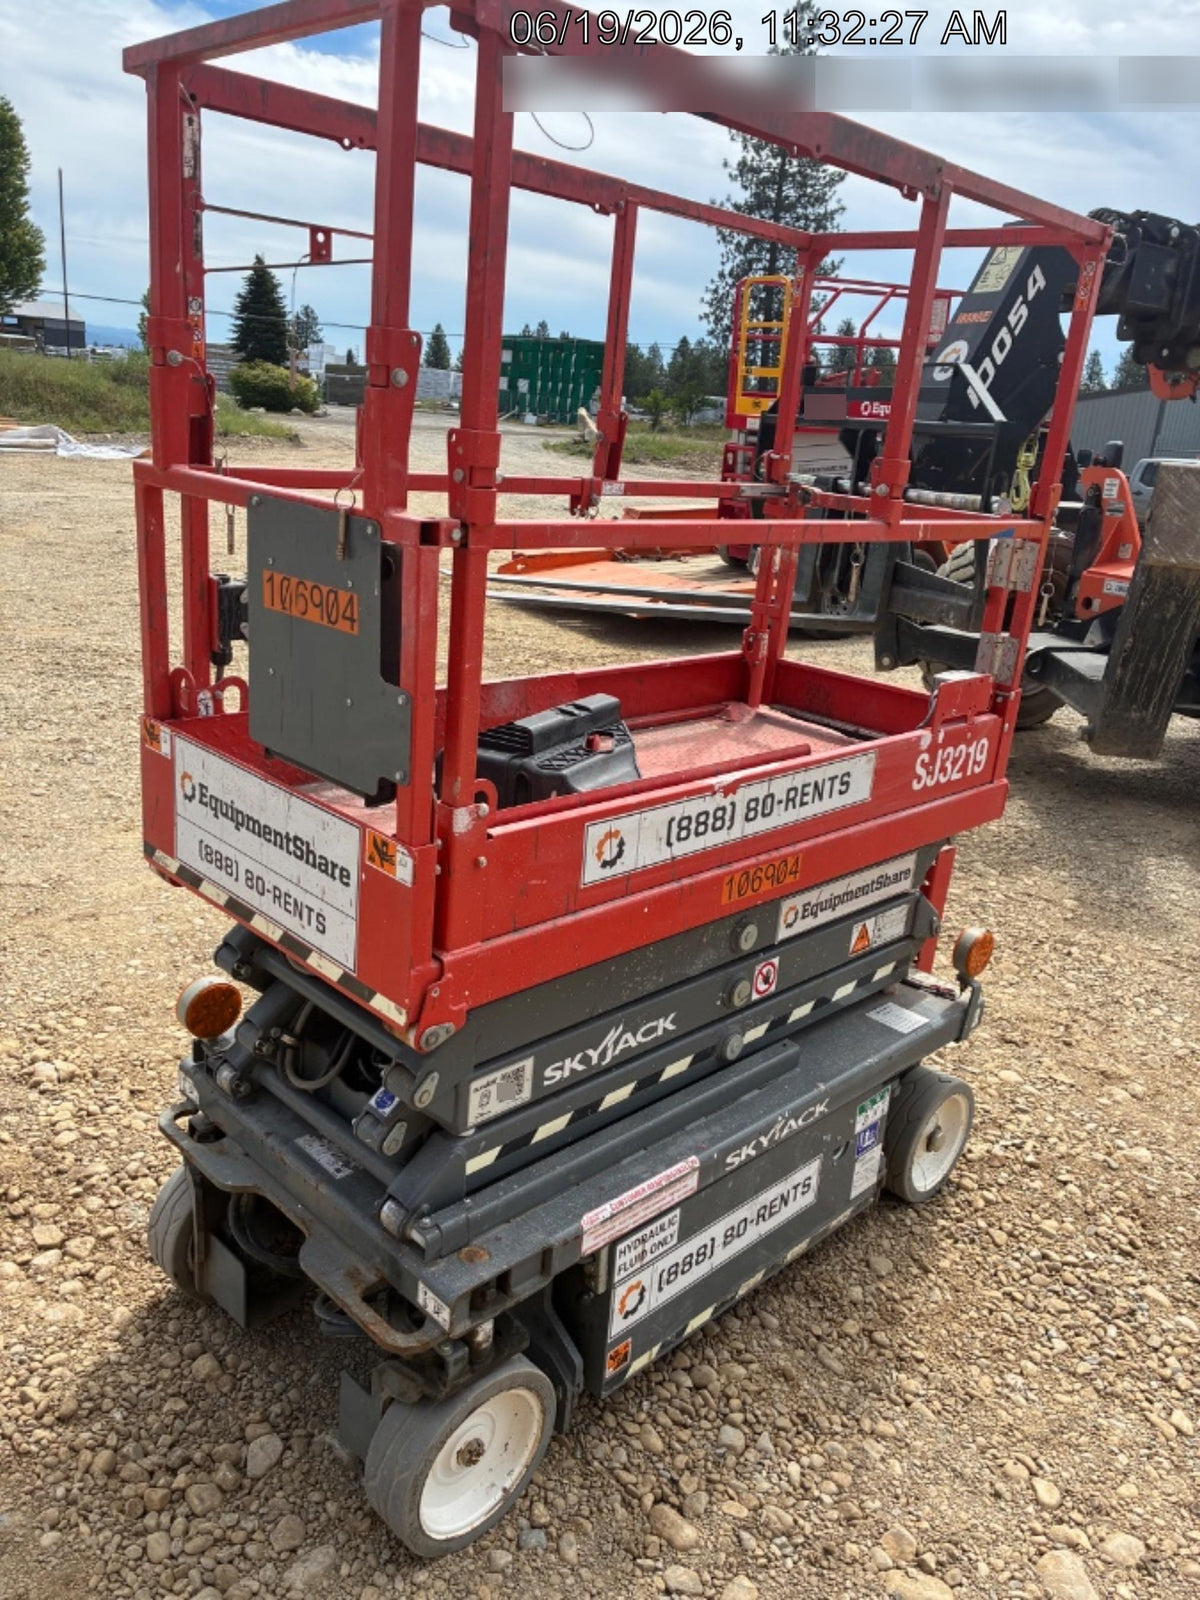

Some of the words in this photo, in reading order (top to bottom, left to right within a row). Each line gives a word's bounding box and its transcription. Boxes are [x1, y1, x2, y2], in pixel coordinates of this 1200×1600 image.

[265, 571, 357, 632] 106904
[911, 737, 989, 791] SJ3219
[198, 782, 352, 888] EquipmentShare
[665, 801, 737, 848] (888)
[744, 771, 852, 823] 80-RENTS
[198, 839, 239, 882] (888)
[244, 868, 327, 936] 80-RENTS
[725, 856, 801, 902] 106904
[800, 867, 912, 920] EquipmentShare
[543, 1011, 678, 1087] SKYJACK
[724, 1097, 830, 1172] SKYJACK
[617, 1249, 648, 1277] FLUID
[649, 1229, 677, 1255] ONLY
[618, 1214, 678, 1260] HYDRAULIC
[657, 1236, 716, 1293] (888)
[722, 1175, 813, 1249] 80-RENTS
